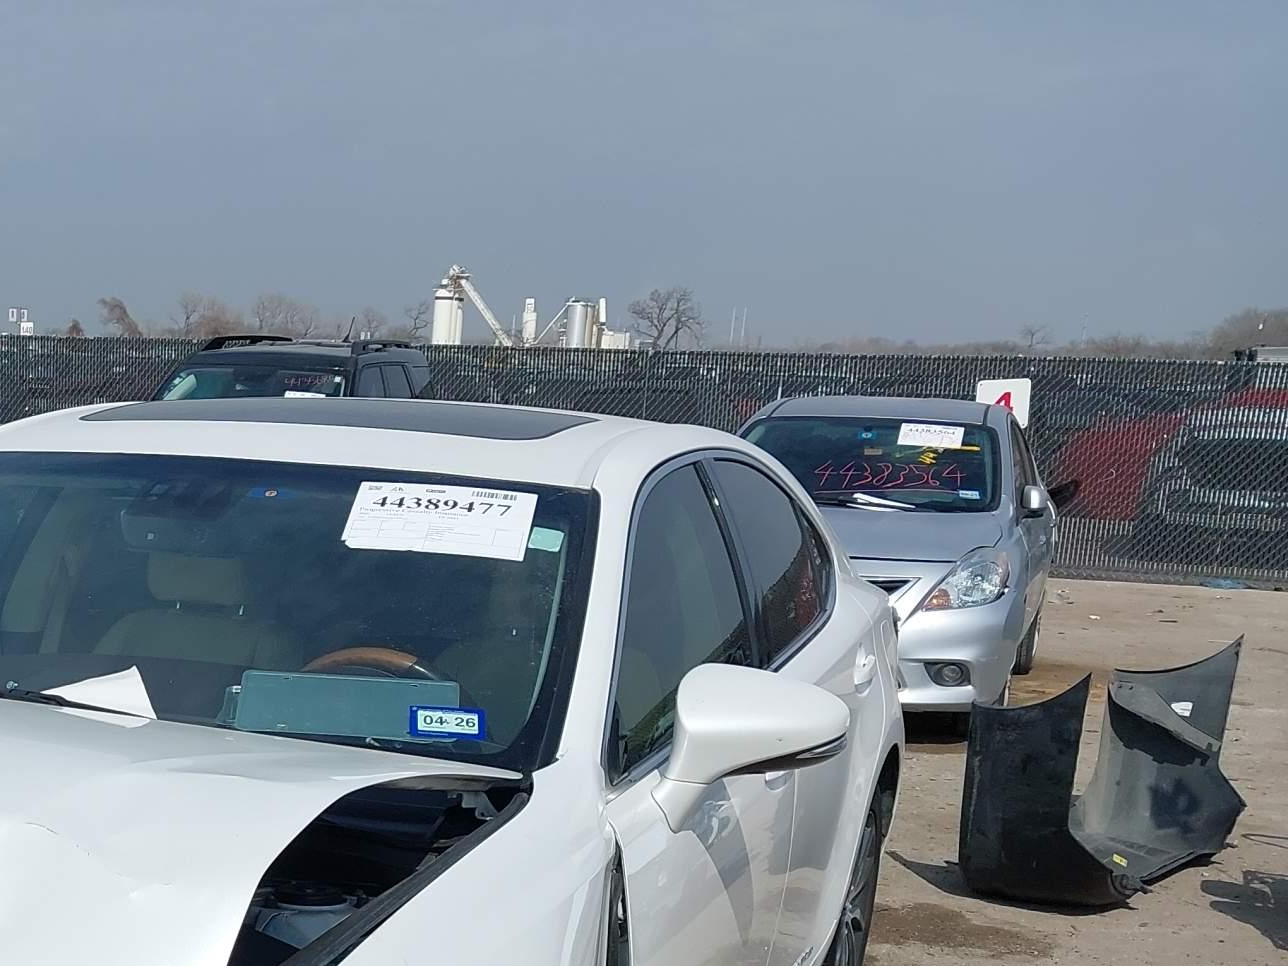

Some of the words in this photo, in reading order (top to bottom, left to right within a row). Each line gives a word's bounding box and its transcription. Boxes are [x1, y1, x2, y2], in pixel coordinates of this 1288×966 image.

[813, 459, 968, 489] 44383564
[372, 495, 513, 517] 44389477
[422, 714, 444, 726] 04
[454, 716, 477, 728] 26
